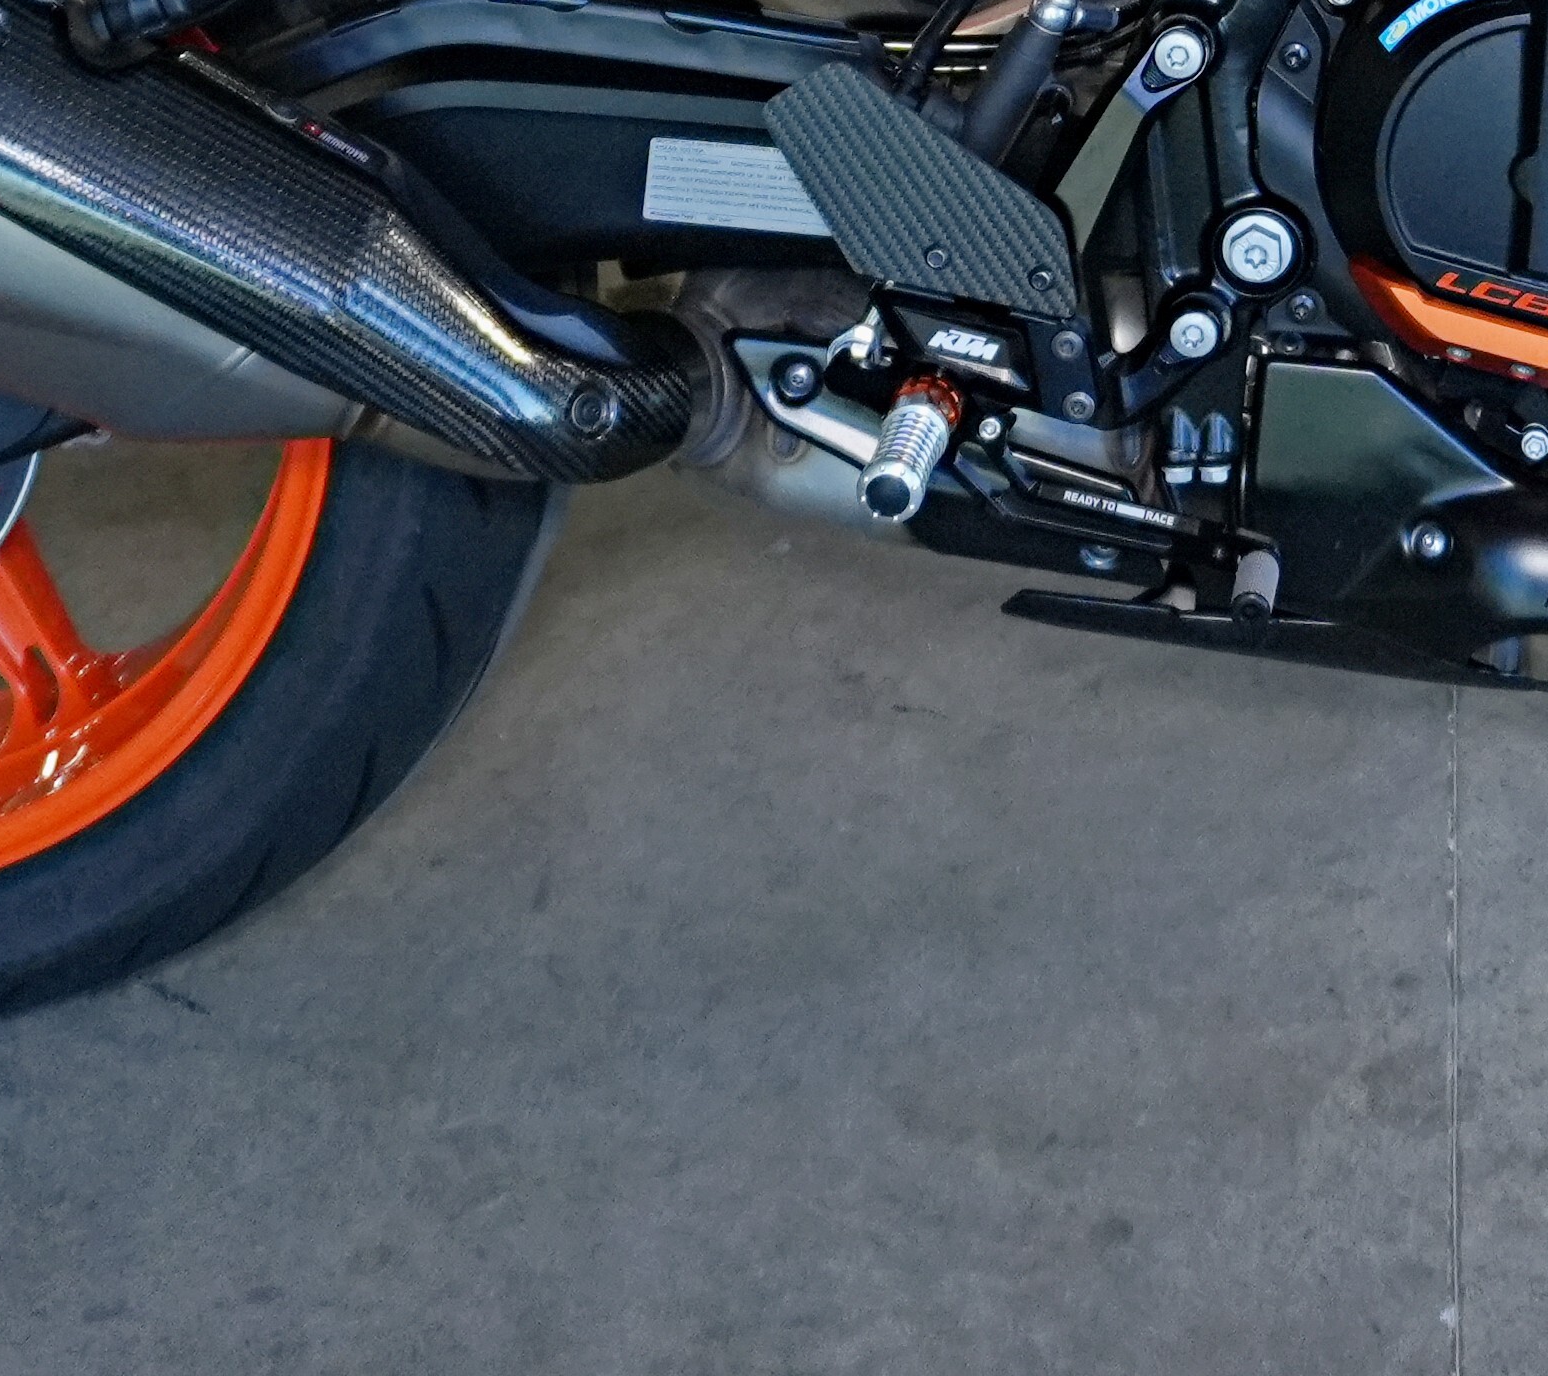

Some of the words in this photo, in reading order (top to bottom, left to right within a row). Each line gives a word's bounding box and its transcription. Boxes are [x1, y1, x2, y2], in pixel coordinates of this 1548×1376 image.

[927, 328, 1000, 361] KTM
[1063, 489, 1100, 509] READY
[1101, 498, 1117, 512] TO
[1144, 509, 1175, 527] RACE
